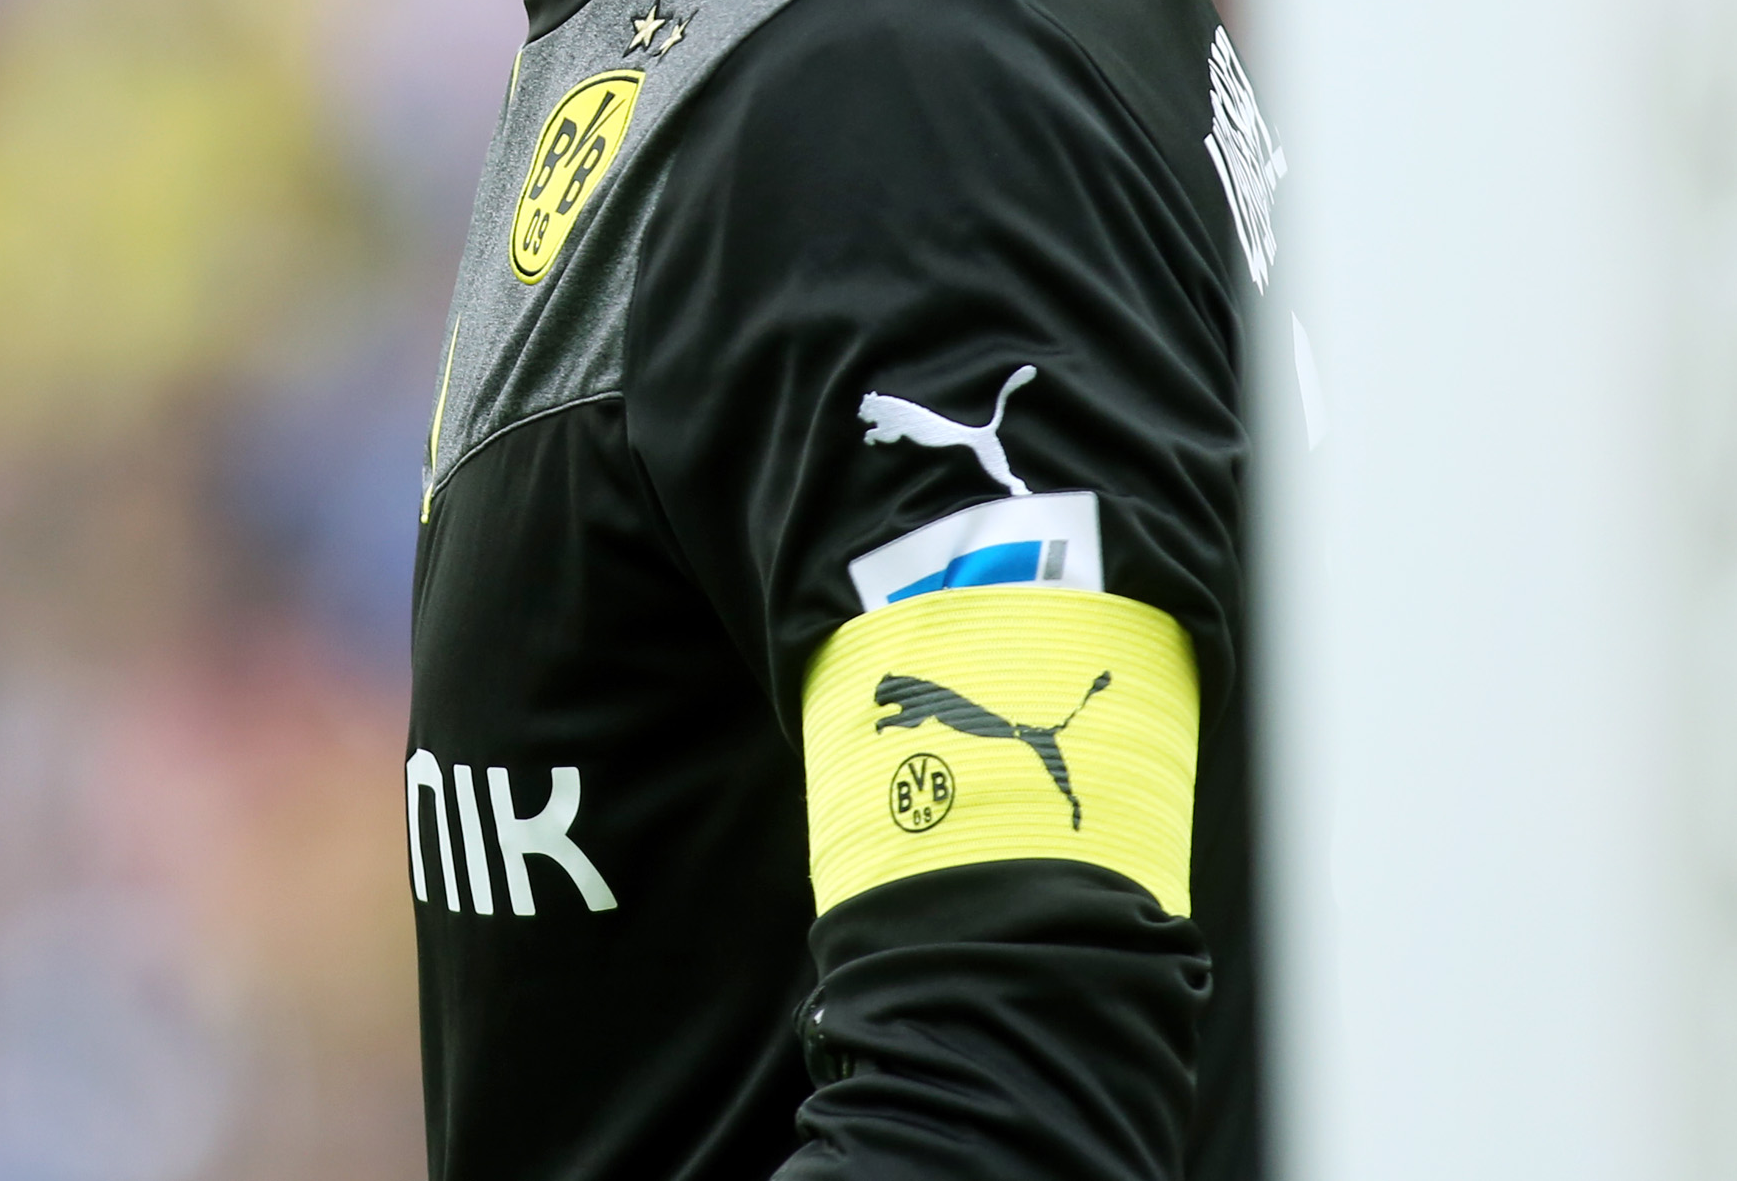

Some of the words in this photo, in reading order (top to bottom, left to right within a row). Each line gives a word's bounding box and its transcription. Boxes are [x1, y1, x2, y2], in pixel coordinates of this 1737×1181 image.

[529, 90, 626, 215] BVB
[523, 208, 550, 256] 09
[897, 758, 949, 813] BVB
[913, 806, 932, 826] 09
